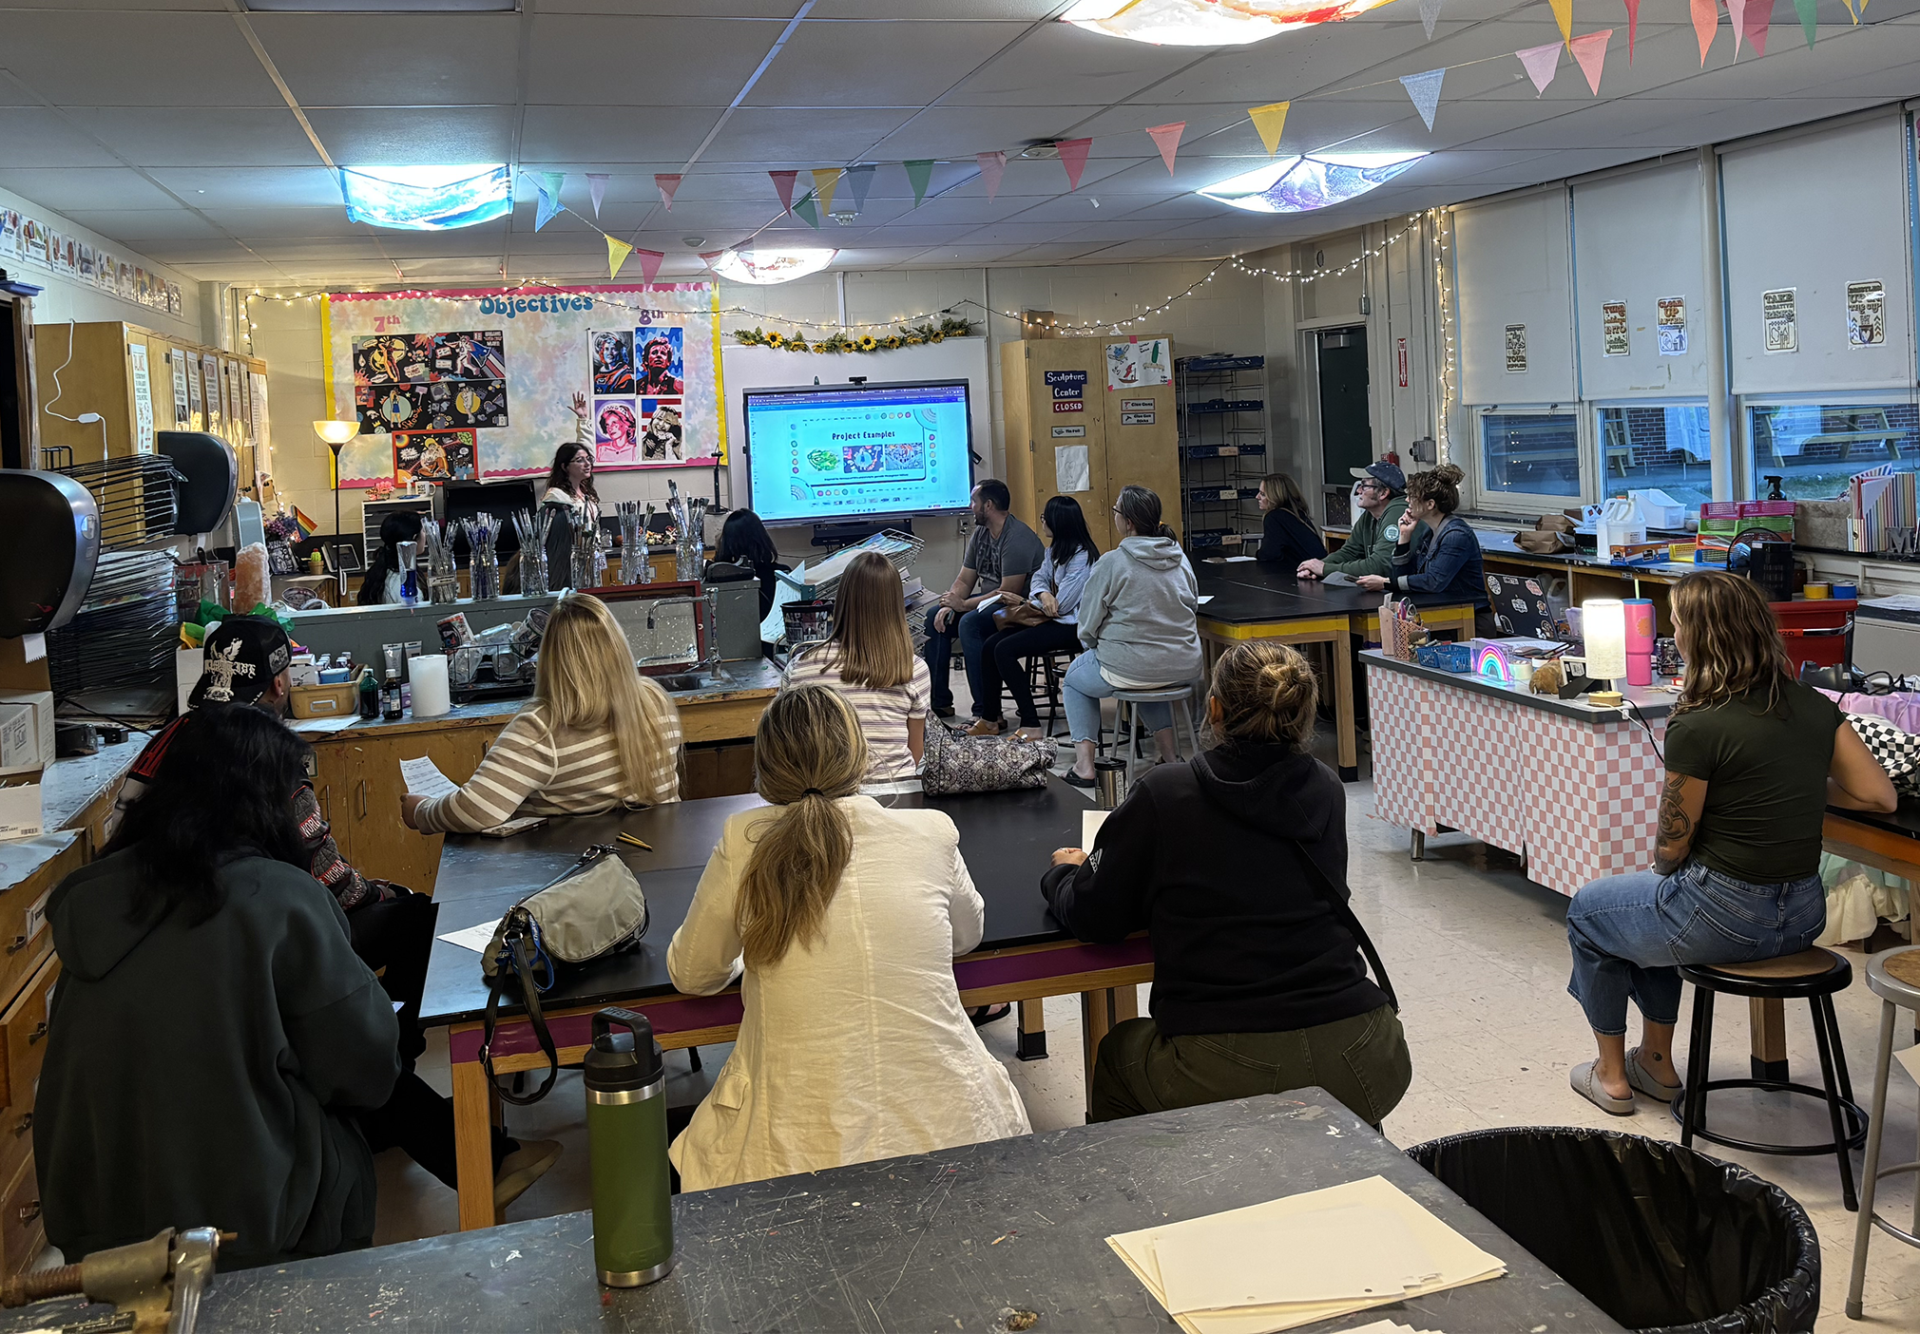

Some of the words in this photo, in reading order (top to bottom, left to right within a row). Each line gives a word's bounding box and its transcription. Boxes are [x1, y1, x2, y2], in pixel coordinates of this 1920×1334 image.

[479, 296, 594, 318] Objectives
[1664, 307, 1679, 317] UP
[639, 309, 665, 326] 8th
[373, 315, 401, 332] 7th
[1047, 372, 1085, 382] Sculpture
[1054, 388, 1080, 397] Center
[1055, 403, 1082, 411] CLOSED
[832, 432, 861, 441] Project
[863, 430, 895, 439] Examples
